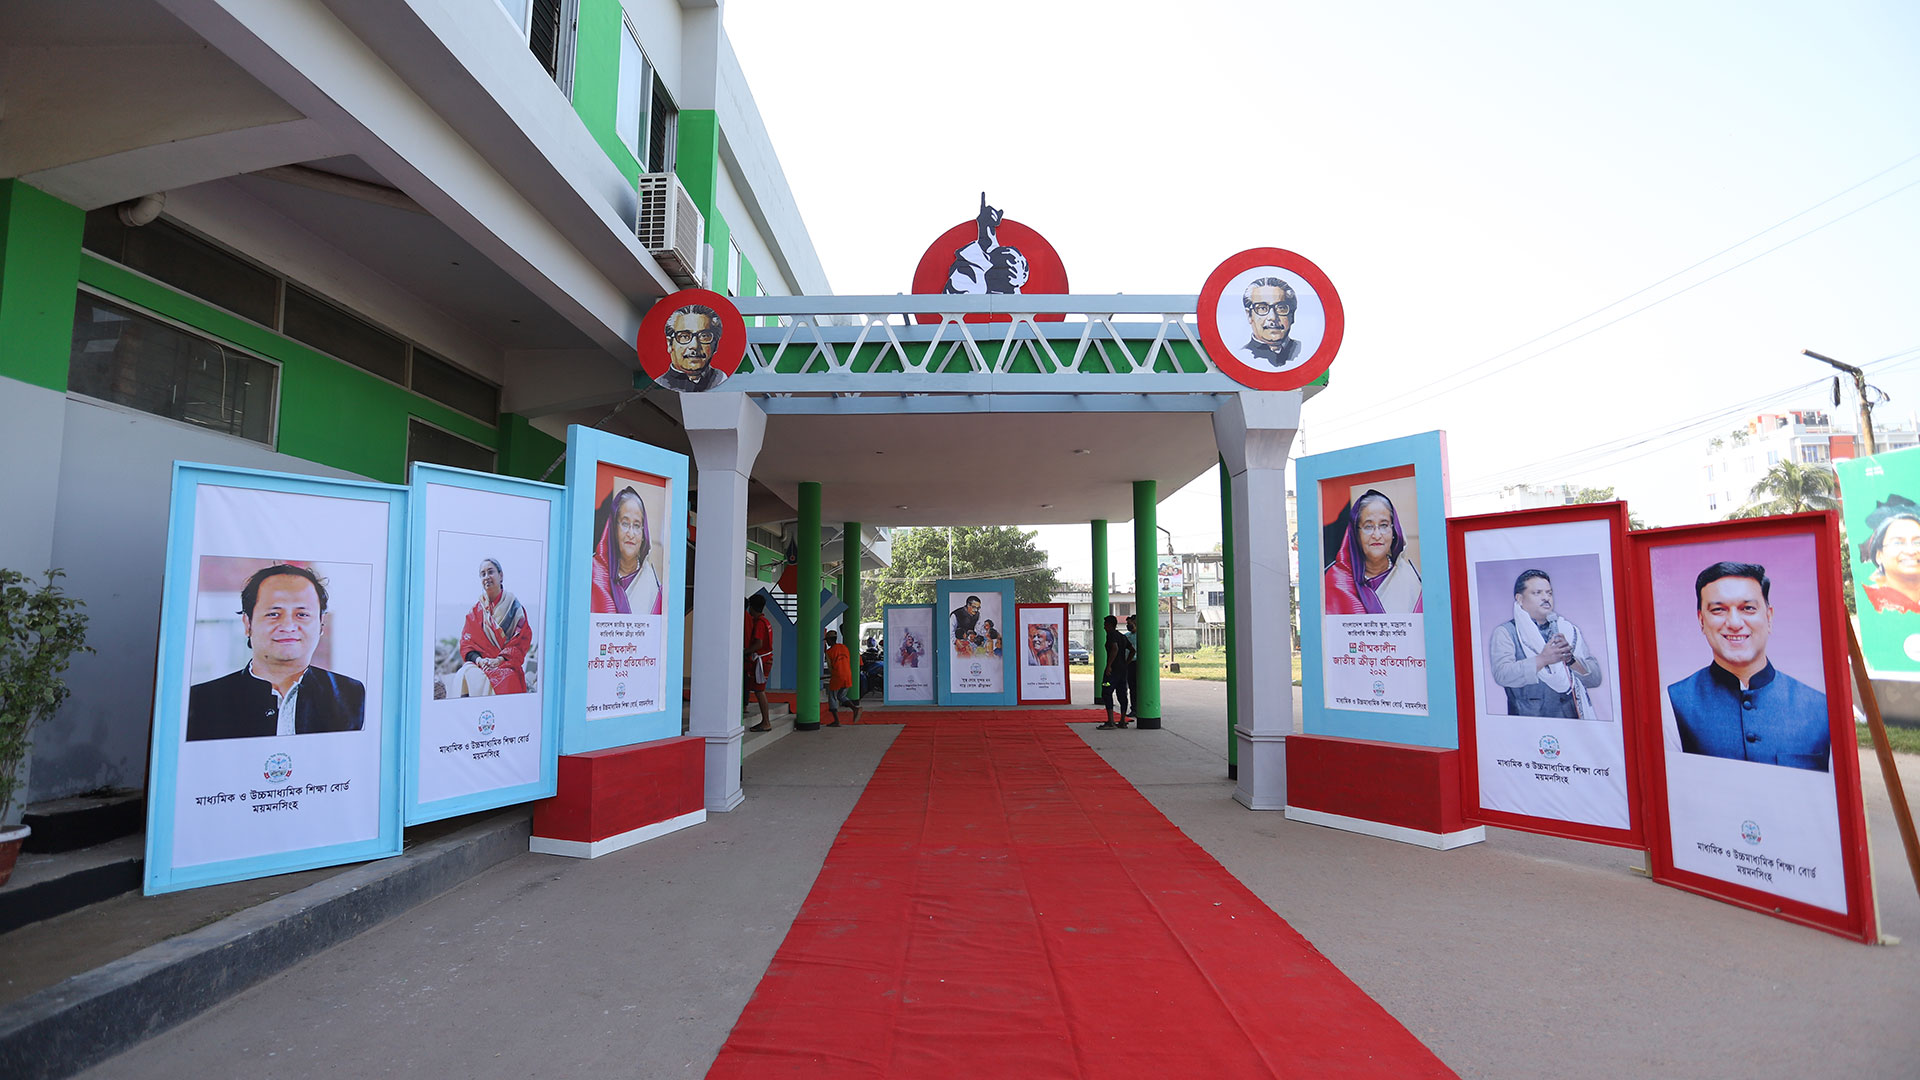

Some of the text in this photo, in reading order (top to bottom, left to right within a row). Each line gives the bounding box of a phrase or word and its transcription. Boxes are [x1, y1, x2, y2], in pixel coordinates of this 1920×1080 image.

[1358, 642, 1396, 653] গ্রীষ্মকালীন
[1333, 654, 1426, 668] জাতীয় ক্রীড়া প্রতিযোগিতা
[1497, 759, 1522, 768] মাধ্যমিক
[1532, 761, 1571, 773] উচ্চমাধ্যমিক
[1573, 764, 1590, 775] শিক্ষা
[1593, 767, 1609, 777] বোর্ড
[1535, 773, 1569, 784] ময়মনসিংহ
[195, 779, 351, 806] মাধ্যমিক ও উচ্চমাধ্যমিক শিক্ষা বোর্ড
[252, 800, 298, 813] ময়মনসিংহ
[1697, 842, 1816, 878] মাধ্যমিক ও উচ্চমাধ্যমিক শিক্ষা বোর্ড
[1737, 865, 1773, 883] ময়মনসিংহ
